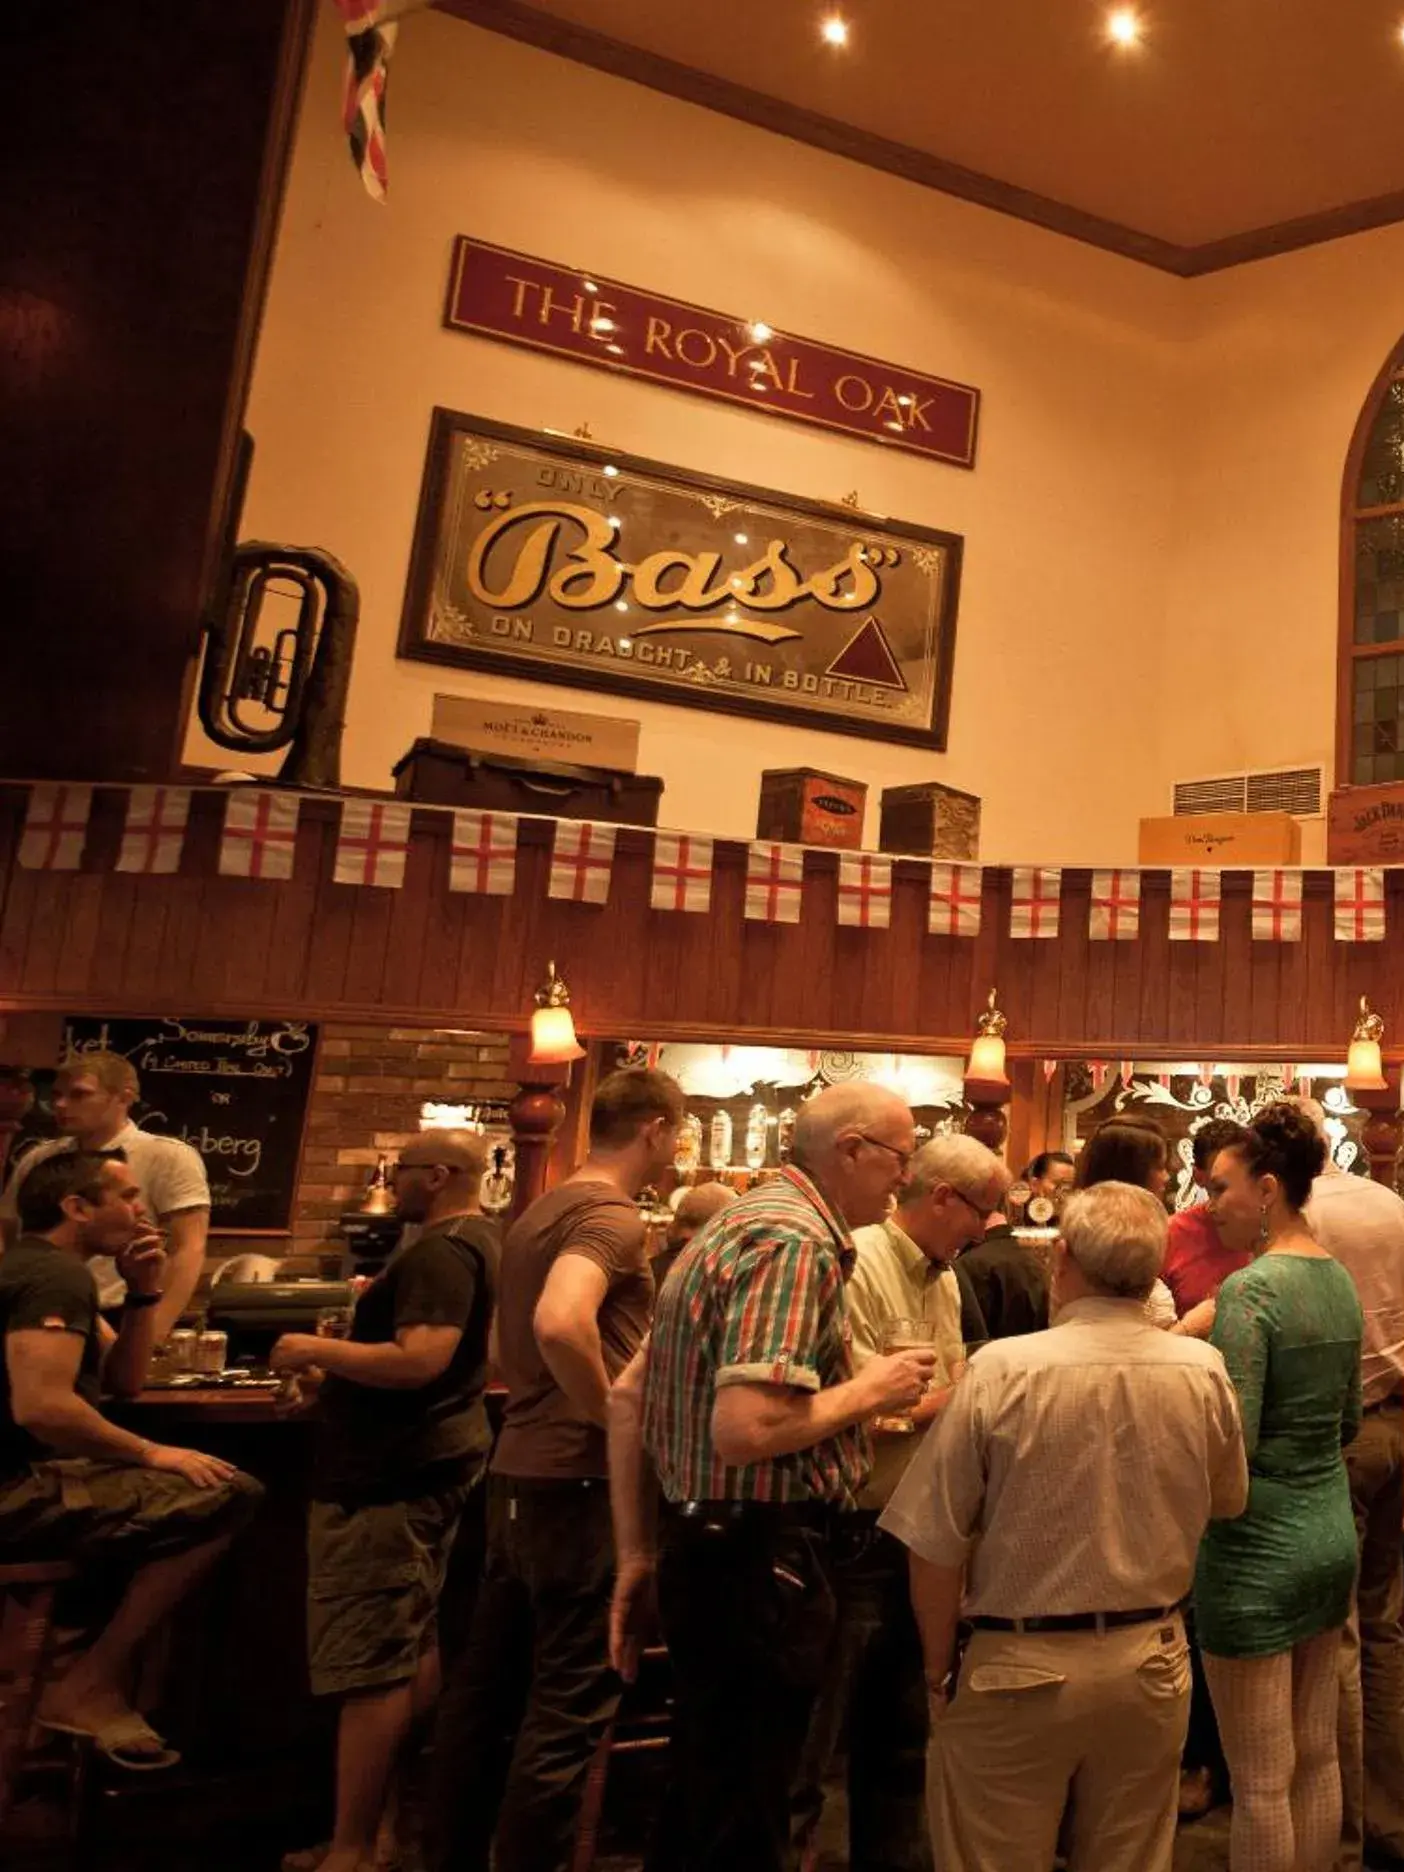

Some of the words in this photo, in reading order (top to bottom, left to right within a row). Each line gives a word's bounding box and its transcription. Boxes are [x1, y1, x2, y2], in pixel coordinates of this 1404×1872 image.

[504, 275, 617, 344] THE
[644, 315, 815, 399] ROYAL
[834, 375, 936, 433] OAK
[536, 466, 627, 503] ONLY
[491, 614, 534, 644] ON
[712, 657, 733, 680] &
[743, 661, 772, 686] IN
